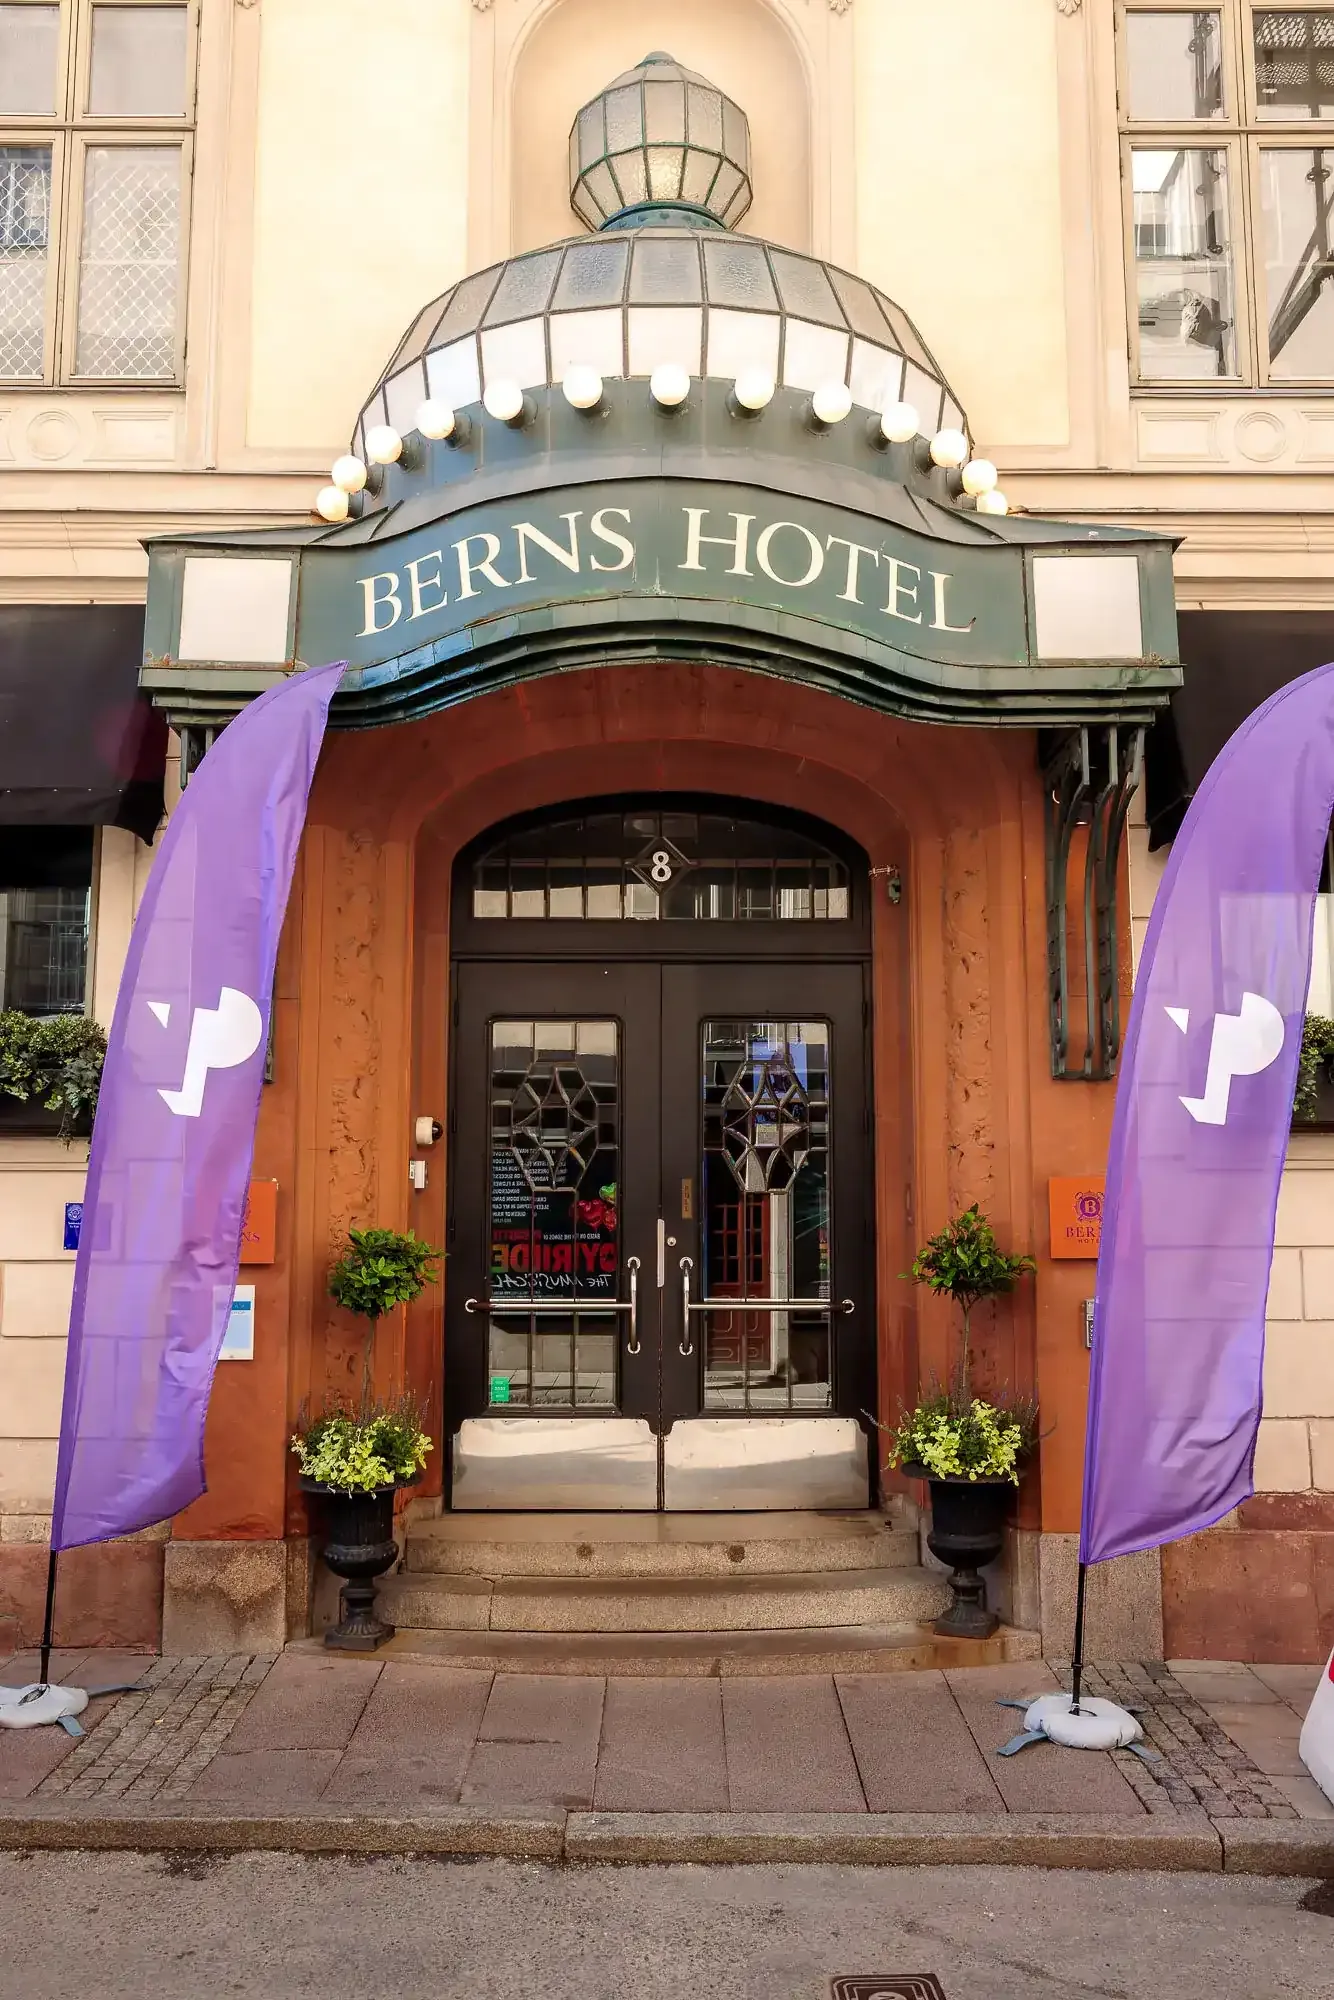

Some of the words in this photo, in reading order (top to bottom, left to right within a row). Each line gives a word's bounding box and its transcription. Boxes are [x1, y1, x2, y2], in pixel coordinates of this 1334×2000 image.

[355, 507, 636, 638] BERNS
[677, 507, 976, 633] HOTEL
[651, 851, 672, 882] 8
